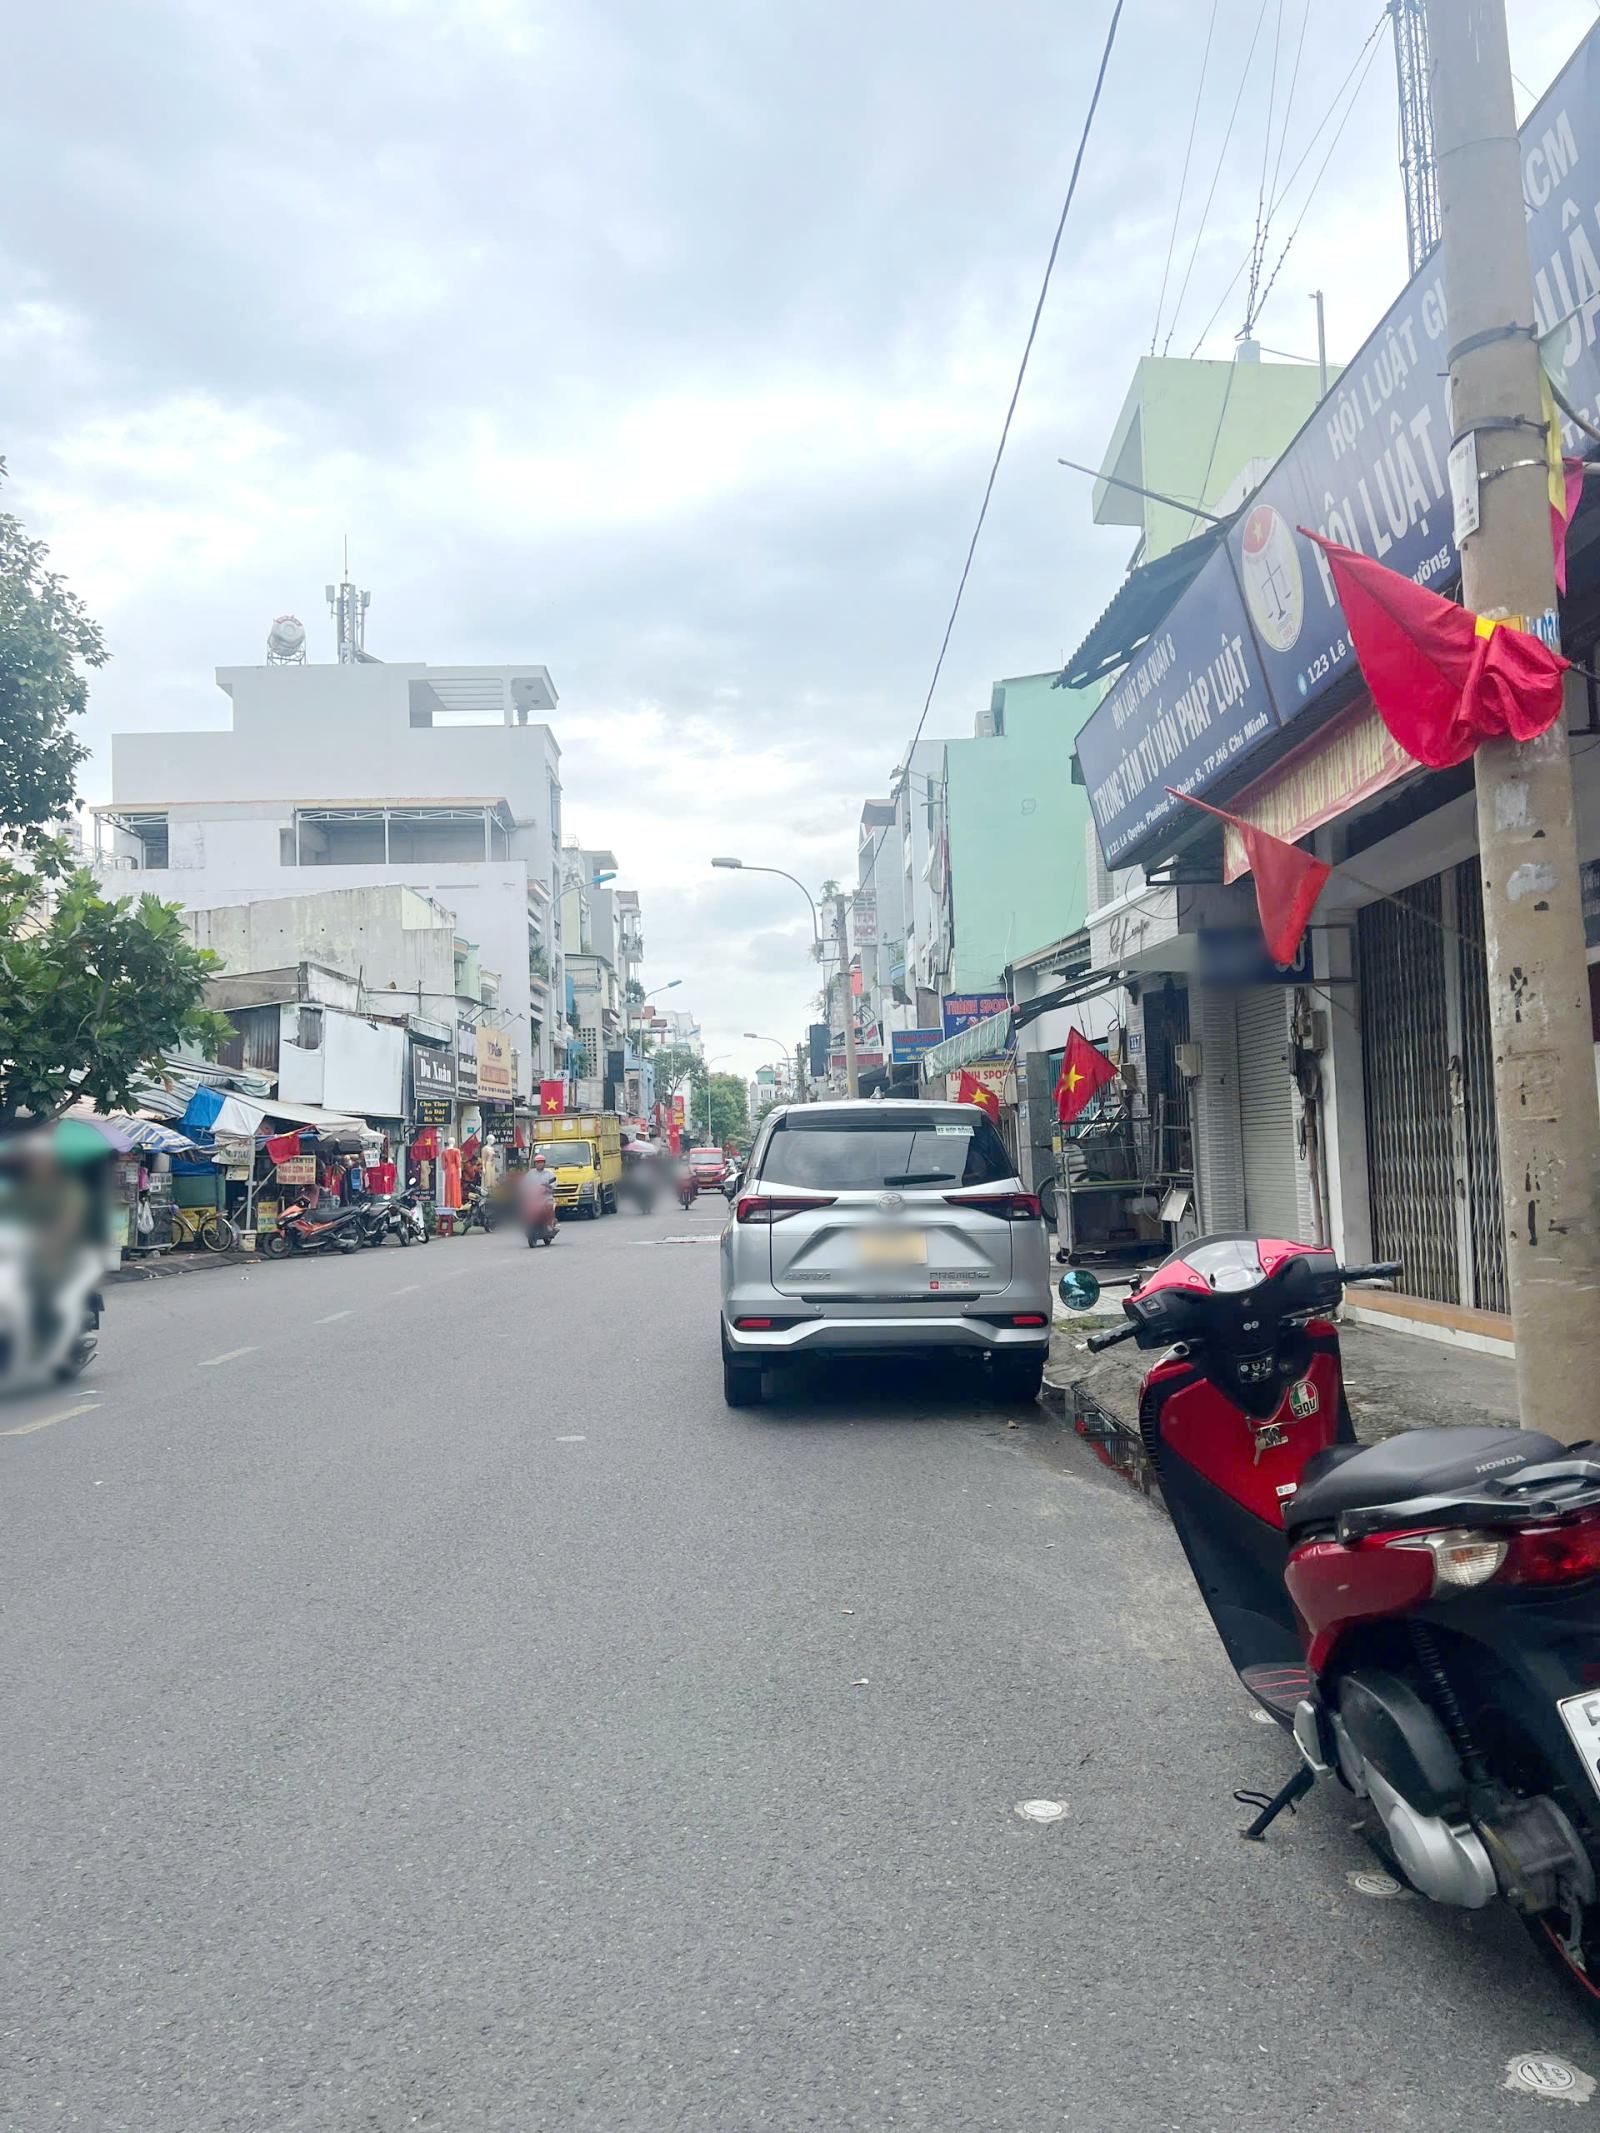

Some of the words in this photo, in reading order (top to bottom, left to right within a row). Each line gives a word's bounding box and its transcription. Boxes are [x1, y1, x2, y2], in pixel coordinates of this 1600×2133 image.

[1326, 389, 1364, 462] HỘI
[1362, 315, 1419, 416] LUẬT
[1421, 277, 1448, 341] GI
[1521, 108, 1580, 224] CM
[1358, 404, 1446, 559] LUẬT
[1148, 640, 1171, 687] QUẬN
[1166, 632, 1176, 662] 8
[1307, 654, 1330, 685] 123
[1329, 639, 1347, 664] Lê
[1093, 772, 1127, 827] TRUNG
[1119, 748, 1146, 801] TÂM
[1152, 698, 1183, 768] VẤN
[1175, 671, 1212, 747] PHÁP
[1207, 633, 1251, 715] LUẬT
[1203, 743, 1229, 774] TP.Hồ
[1228, 730, 1244, 753] Chí
[1243, 712, 1269, 741] Minh
[945, 997, 977, 1015] THÀNH
[432, 1061, 452, 1083] Xuân
[1474, 1455, 1527, 1473] HONDA
